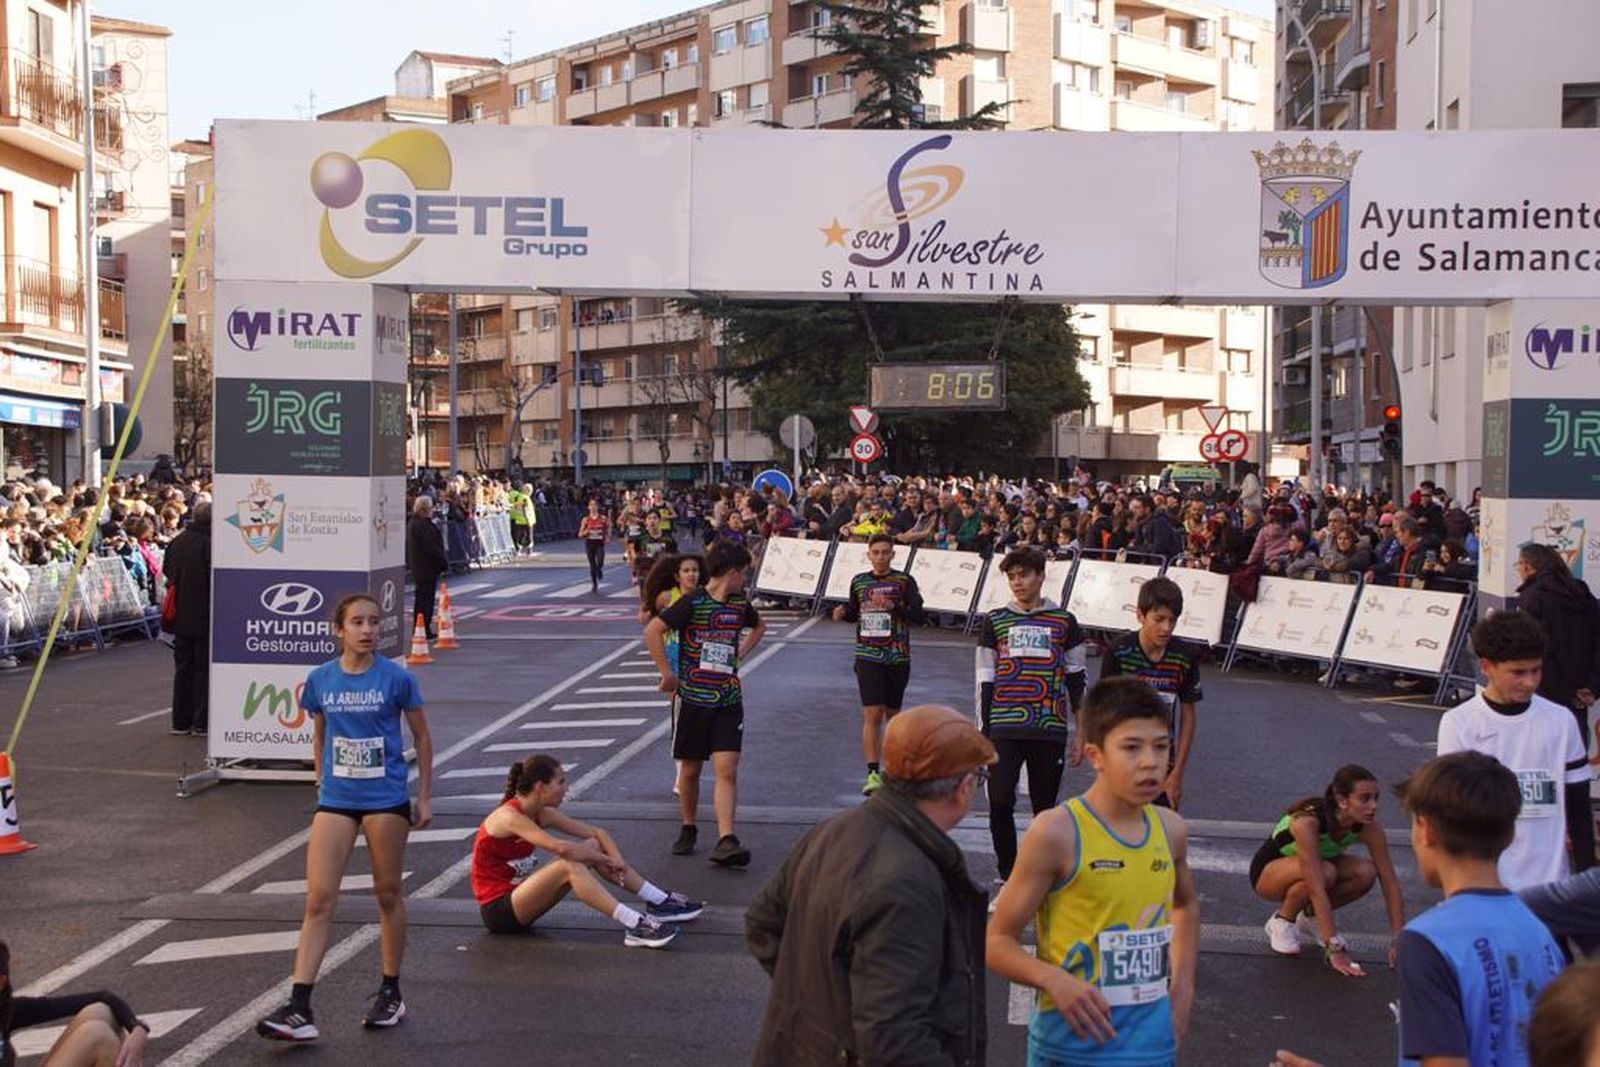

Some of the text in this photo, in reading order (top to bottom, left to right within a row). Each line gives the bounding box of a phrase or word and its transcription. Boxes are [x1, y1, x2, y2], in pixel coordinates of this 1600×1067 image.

[364, 193, 588, 238] SETEL
[503, 237, 588, 258] Grupo
[851, 227, 895, 252] san
[1360, 241, 1401, 271] de
[821, 270, 1043, 291] SALMANTINA
[293, 339, 356, 351] fertilizantes
[926, 372, 994, 400] 8:06
[856, 443, 873, 454] 30
[287, 512, 363, 524] San Estanislao
[287, 524, 338, 535] de Kostka
[246, 637, 336, 654] Gestorauto
[322, 688, 385, 705] LA ARMUÑA
[1113, 947, 1162, 980] 5490
[1472, 936, 1503, 1027] ATLETISMO
